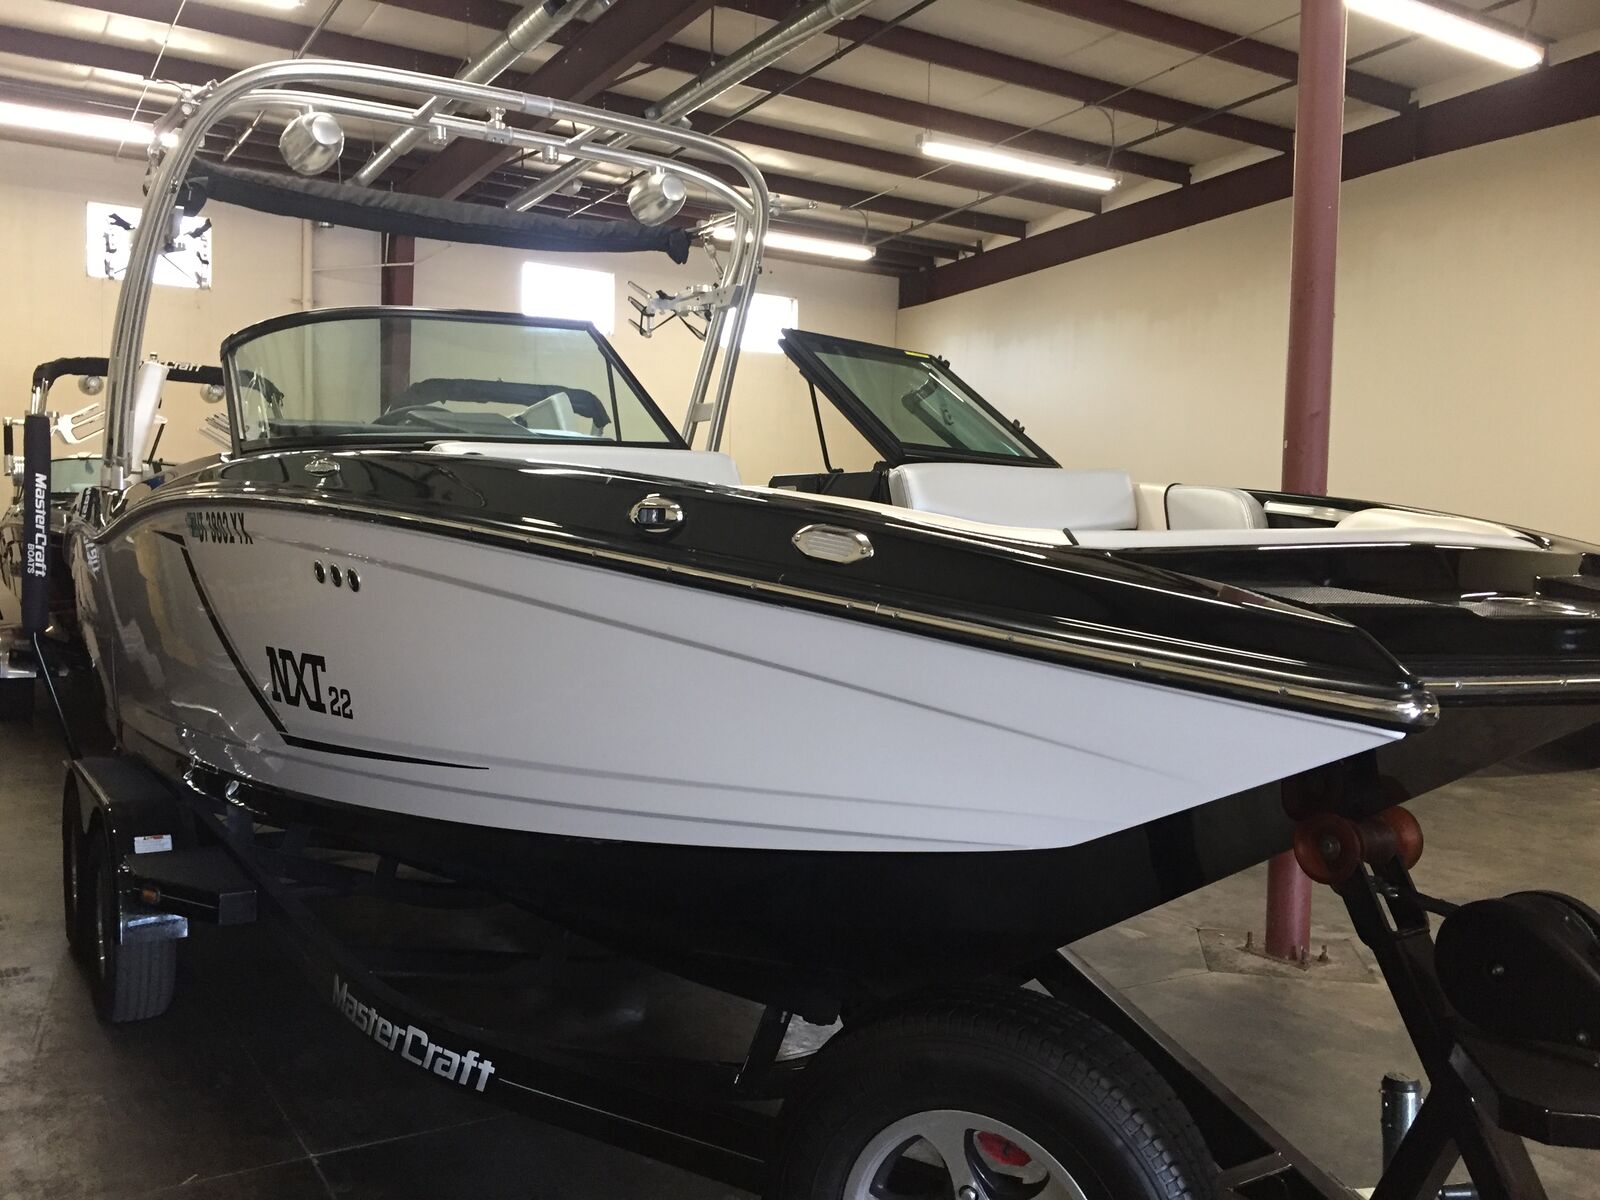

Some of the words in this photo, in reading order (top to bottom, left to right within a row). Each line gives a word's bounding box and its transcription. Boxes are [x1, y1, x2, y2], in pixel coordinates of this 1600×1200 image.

[27, 543, 35, 574] BOATS
[35, 472, 47, 577] MasterCraft
[266, 646, 326, 713] NXT
[328, 686, 353, 719] 22
[332, 973, 495, 1093] MasterCraft
